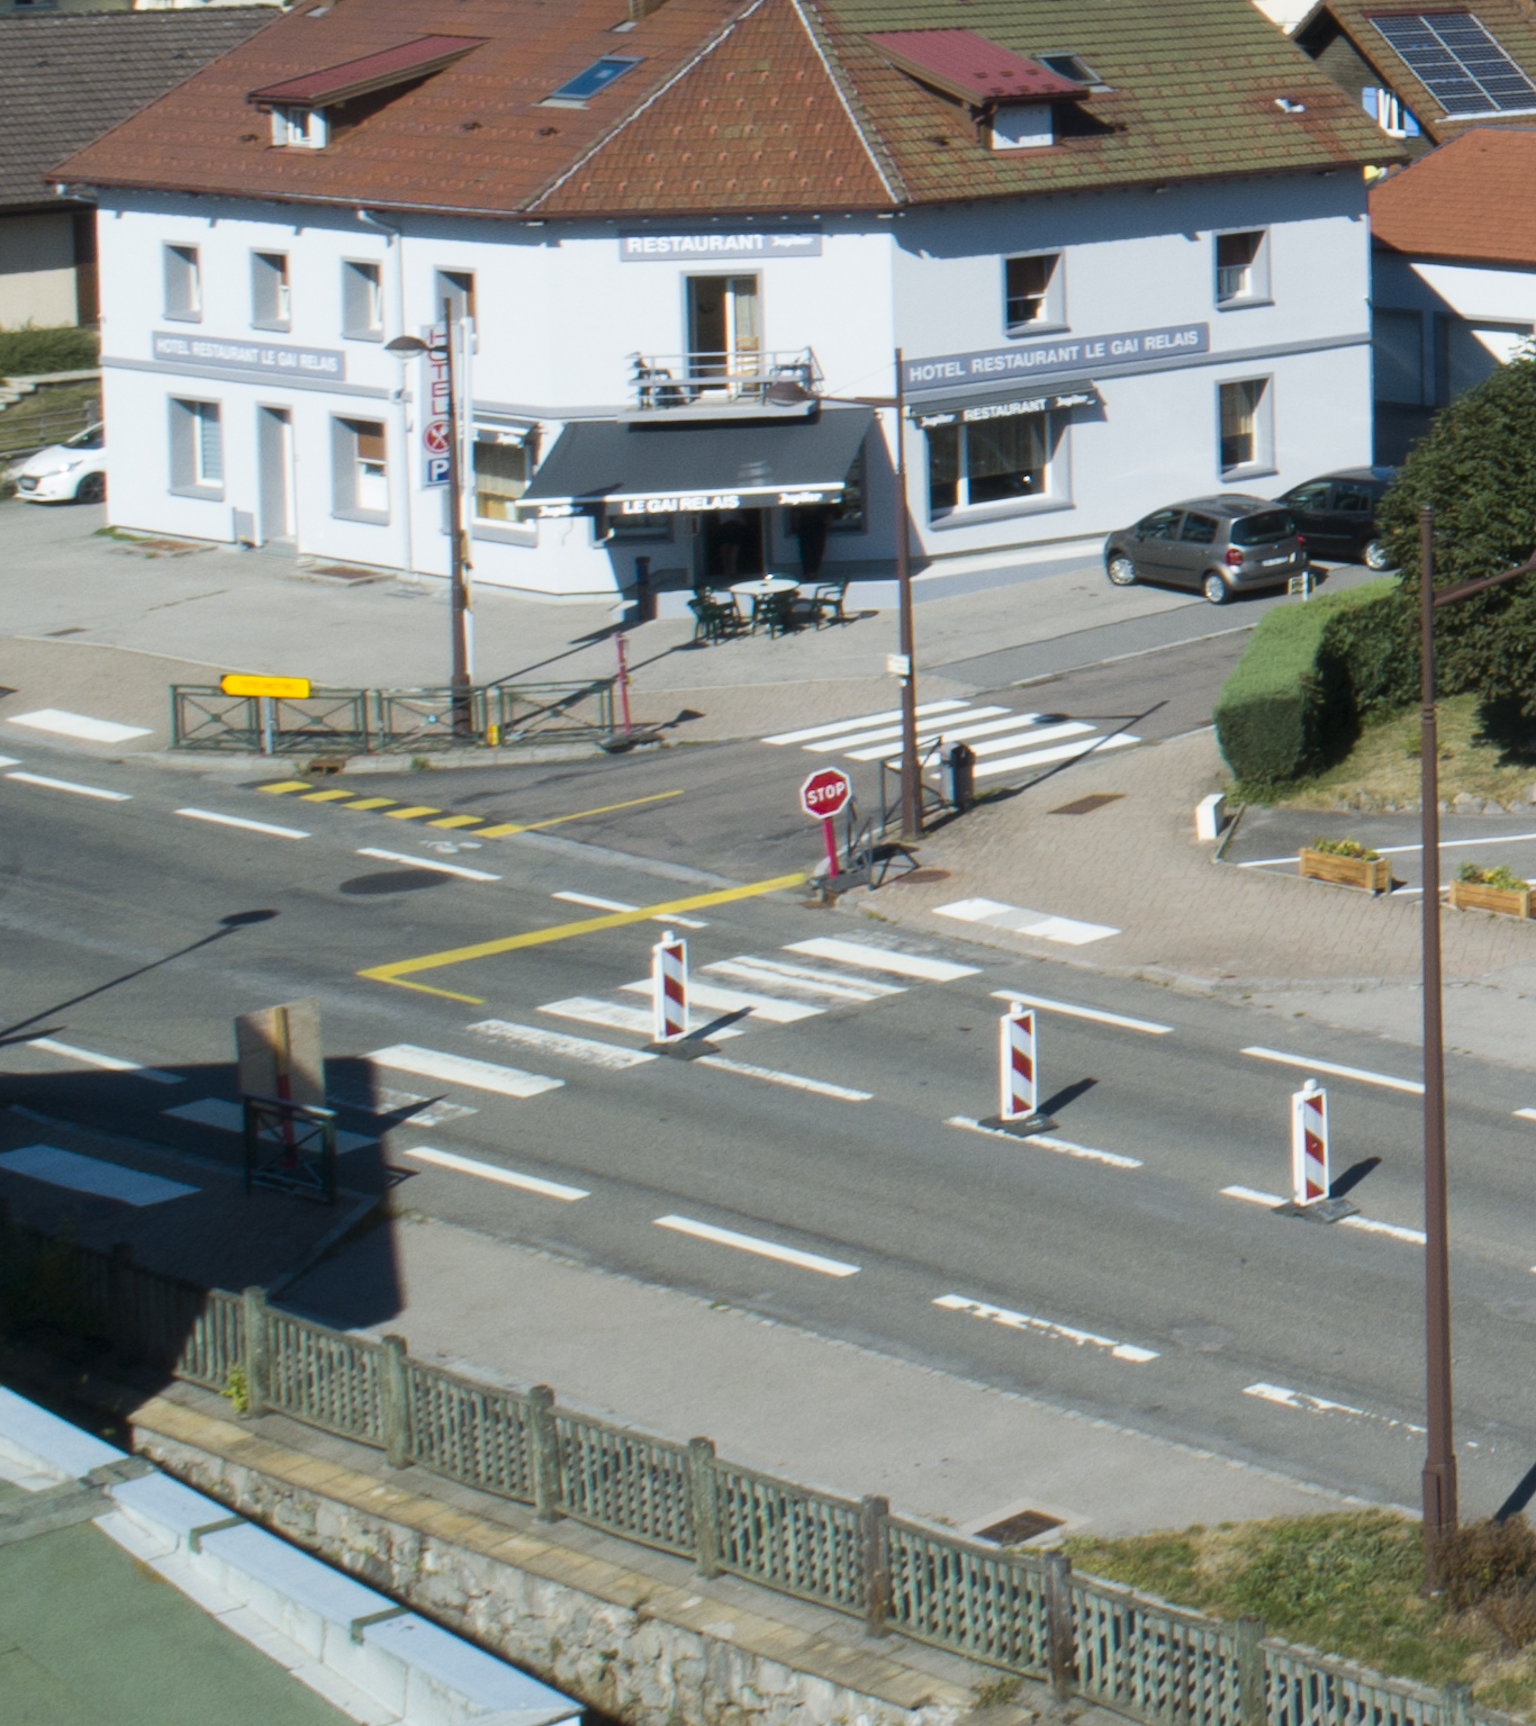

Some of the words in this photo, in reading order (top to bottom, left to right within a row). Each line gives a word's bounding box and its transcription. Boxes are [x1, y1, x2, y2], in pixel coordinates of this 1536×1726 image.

[627, 235, 764, 253] RESTAURANT
[155, 338, 190, 355] HOTEL
[192, 341, 259, 363] RESTAURANT
[261, 349, 276, 366] LE
[277, 351, 298, 367] GAI
[300, 354, 339, 372] RELAIS
[909, 362, 965, 382] HOTEL
[971, 346, 1080, 373] RESTAURANT
[1085, 343, 1105, 359] LE
[1111, 338, 1138, 355] GAI
[1144, 330, 1199, 351] RELAIS
[963, 398, 1048, 422] RESTAURANT
[431, 460, 450, 482] P
[623, 500, 645, 514] LE
[646, 497, 678, 513] GAI
[679, 495, 741, 511] RELAIS
[807, 781, 846, 805] STOP
